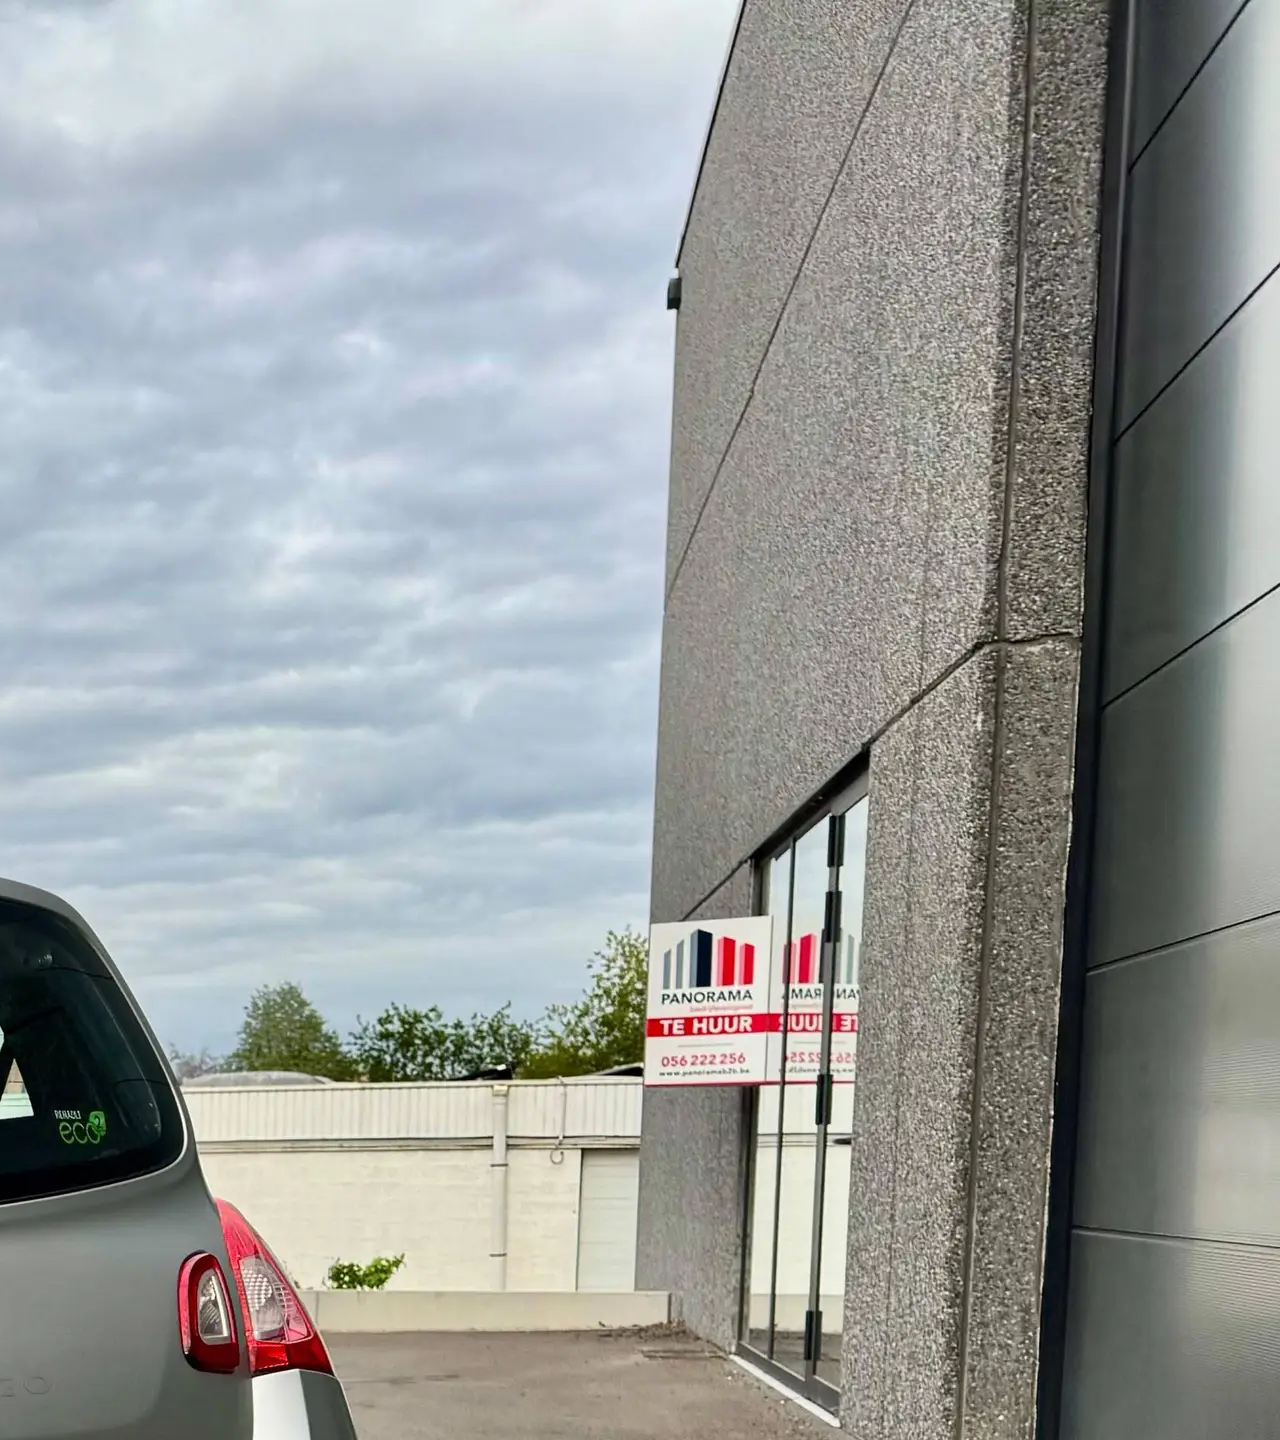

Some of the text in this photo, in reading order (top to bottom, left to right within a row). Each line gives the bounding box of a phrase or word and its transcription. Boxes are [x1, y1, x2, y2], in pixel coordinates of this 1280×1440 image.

[661, 989, 753, 1005] PANORAMA
[659, 1016, 753, 1035] TE HUUR
[661, 1052, 746, 1067] 056 222 256
